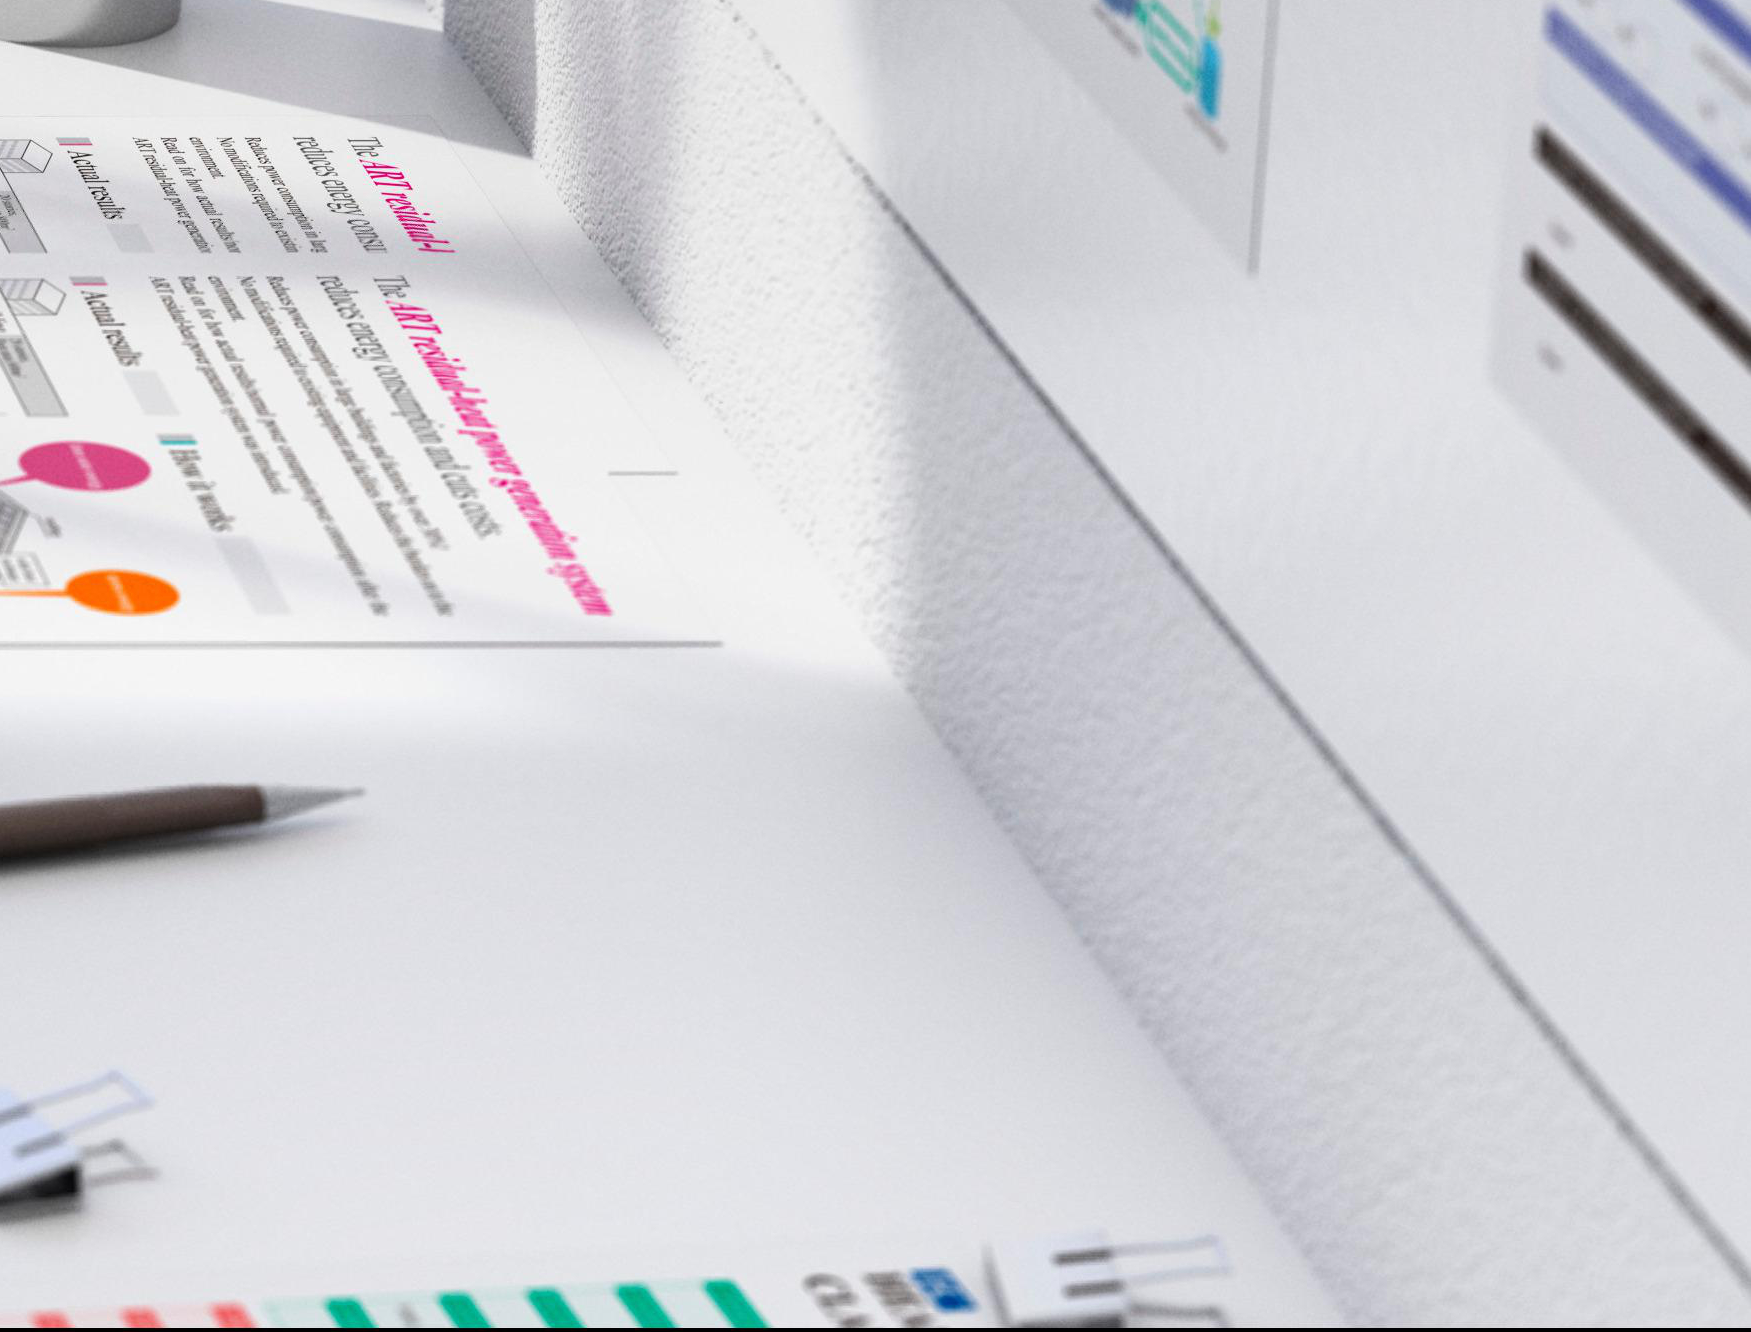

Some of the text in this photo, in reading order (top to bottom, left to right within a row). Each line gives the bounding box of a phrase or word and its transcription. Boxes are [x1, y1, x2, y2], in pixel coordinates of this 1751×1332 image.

[188, 137, 225, 180] environment.
[244, 137, 274, 166] Reduces
[347, 136, 384, 158] The
[67, 150, 126, 220] Actual results
[257, 165, 286, 187] power
[292, 136, 339, 177] reduces
[321, 179, 365, 216] energy
[359, 159, 413, 191] ART
[275, 187, 314, 231] consumption
[372, 274, 412, 298] The
[80, 290, 142, 367] Actual results
[385, 300, 443, 334] ART
[315, 274, 365, 320] reduces
[345, 322, 390, 362] energy
[373, 365, 443, 443] consumption
[424, 446, 470, 470] and
[408, 336, 494, 428] residual-heat
[457, 429, 522, 476] power
[490, 479, 576, 560] generation
